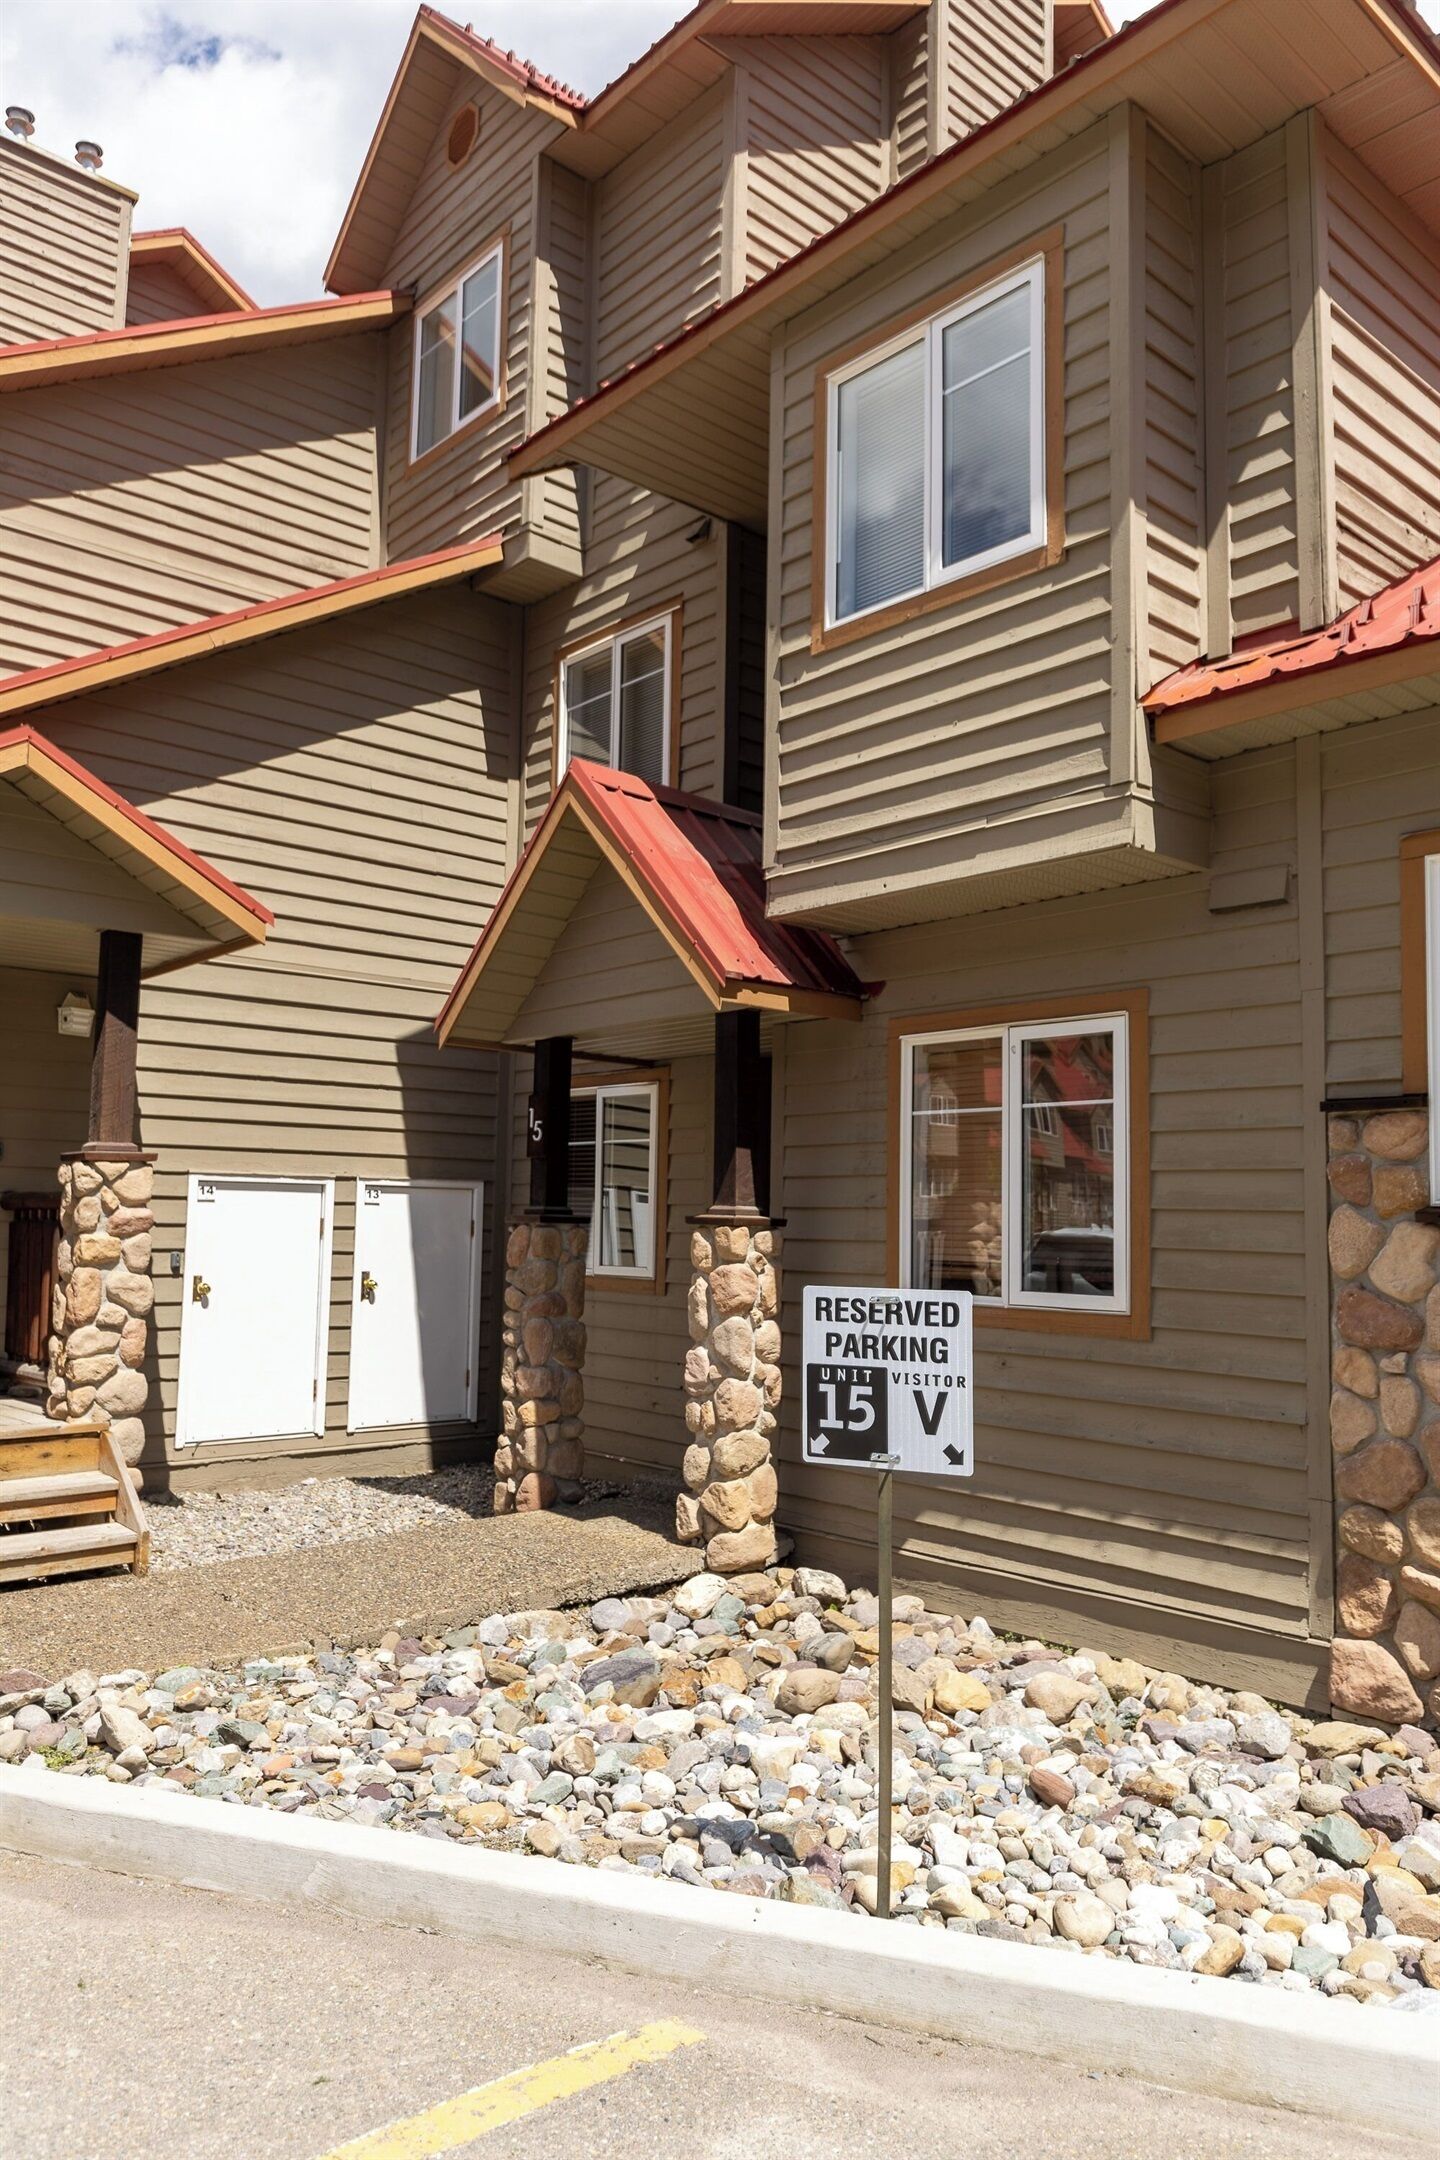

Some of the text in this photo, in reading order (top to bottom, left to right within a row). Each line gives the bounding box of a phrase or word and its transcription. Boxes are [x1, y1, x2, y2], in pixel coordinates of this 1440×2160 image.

[529, 1107, 543, 1141] 15
[199, 1186, 214, 1195] 14
[366, 1190, 380, 1199] 13
[815, 1296, 960, 1328] RESERVED
[825, 1332, 948, 1364] PARKING
[821, 1367, 872, 1383] UNIT
[891, 1372, 967, 1389] VISITOR
[818, 1383, 876, 1432] 15
[912, 1390, 949, 1436] V
